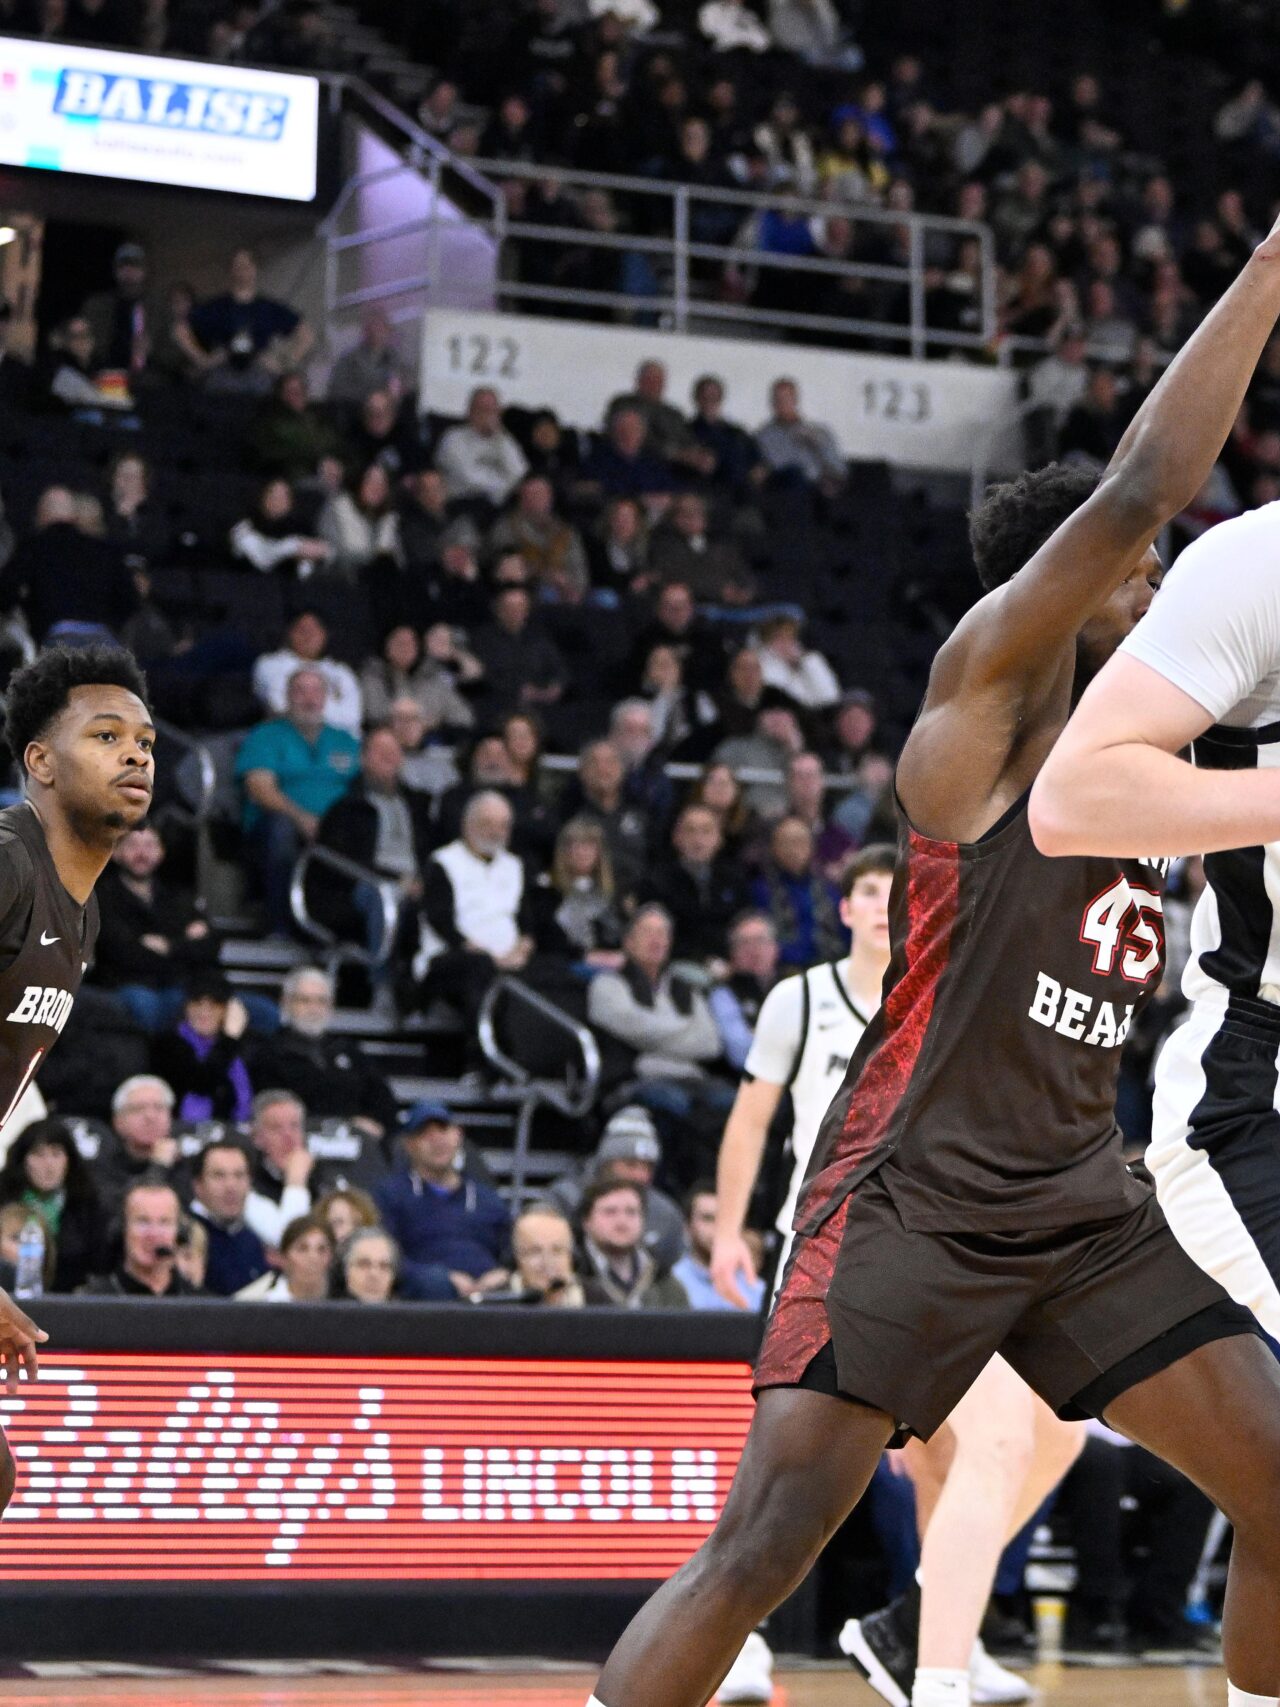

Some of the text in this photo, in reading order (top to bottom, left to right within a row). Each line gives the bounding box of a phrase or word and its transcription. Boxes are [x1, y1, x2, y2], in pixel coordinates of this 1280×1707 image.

[60, 71, 286, 138] BALISE
[445, 333, 521, 379] 122
[862, 378, 933, 423] 123
[1079, 872, 1165, 984] 45
[421, 1448, 719, 1522] LINCOLN
